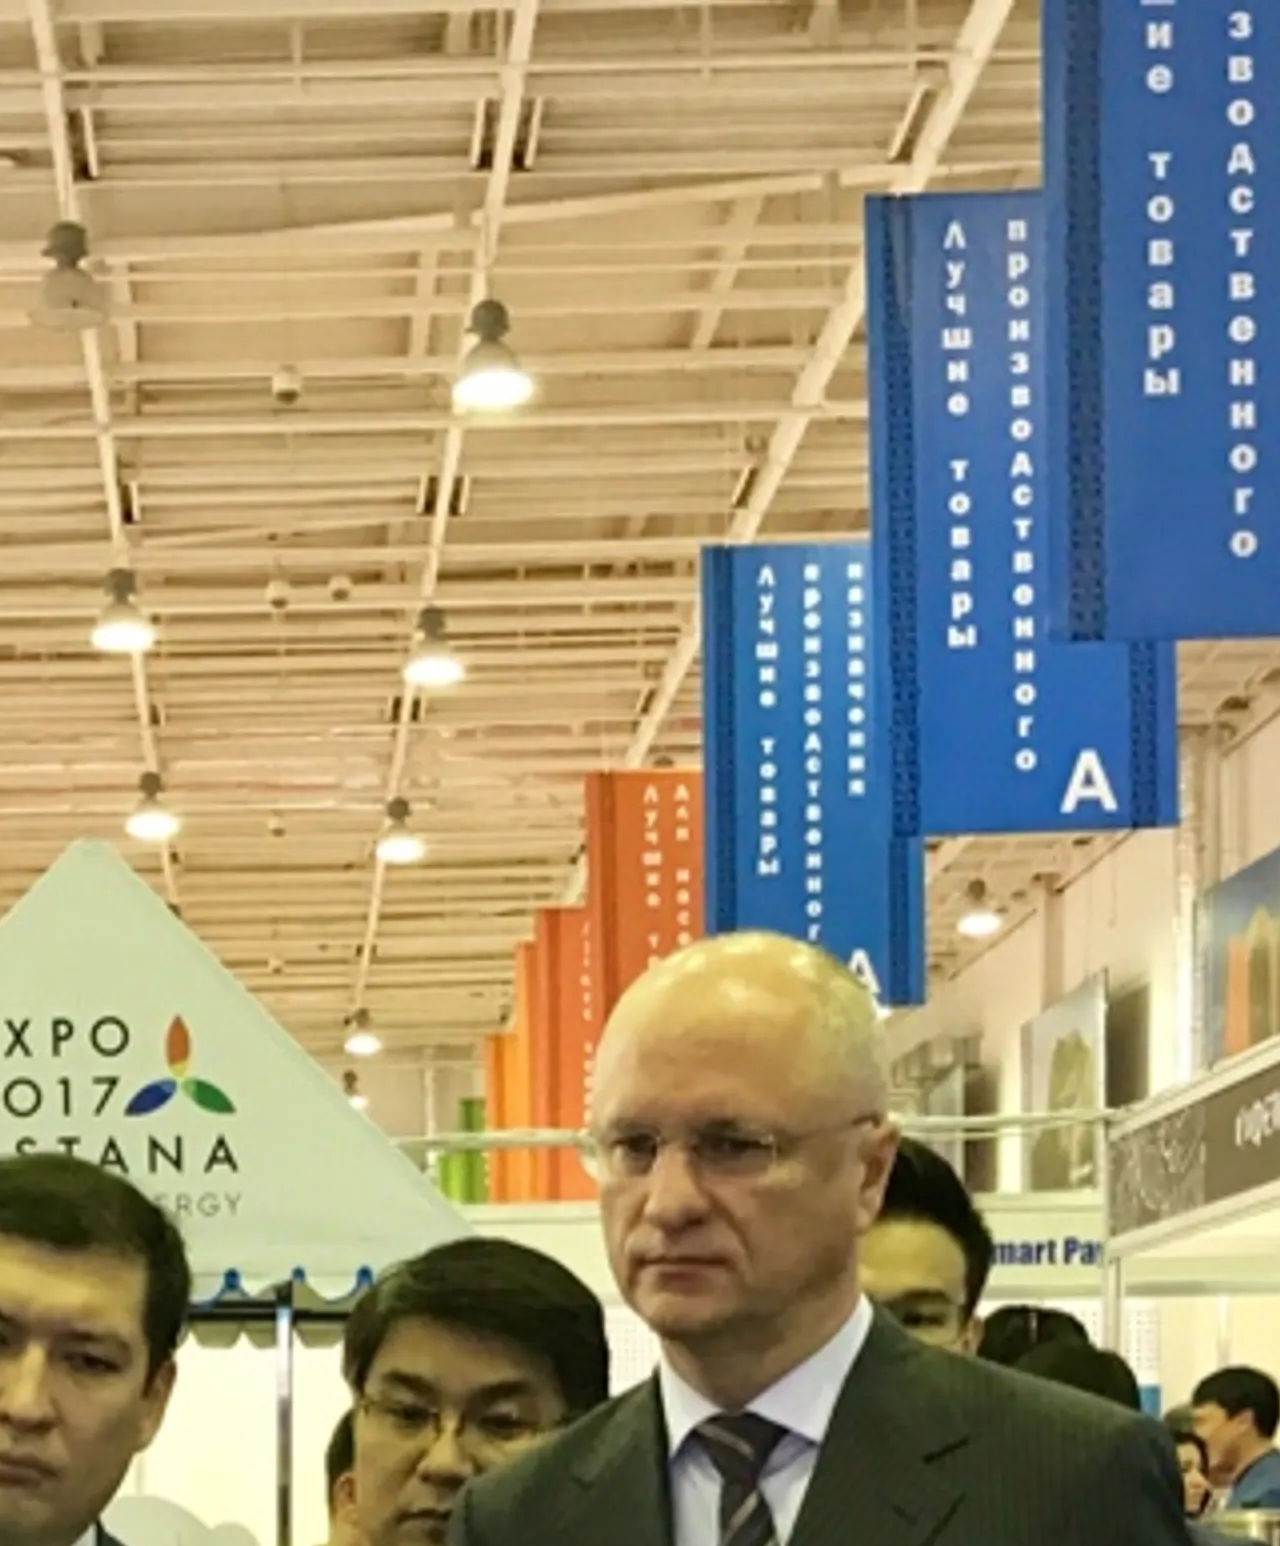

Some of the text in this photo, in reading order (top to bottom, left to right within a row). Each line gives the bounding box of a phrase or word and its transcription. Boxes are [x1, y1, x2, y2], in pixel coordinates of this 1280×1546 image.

[942, 220, 978, 648] Лучшие товары
[1143, 152, 1181, 395] товары
[1006, 218, 1038, 772] производственного
[754, 565, 781, 875] Лучшие товары
